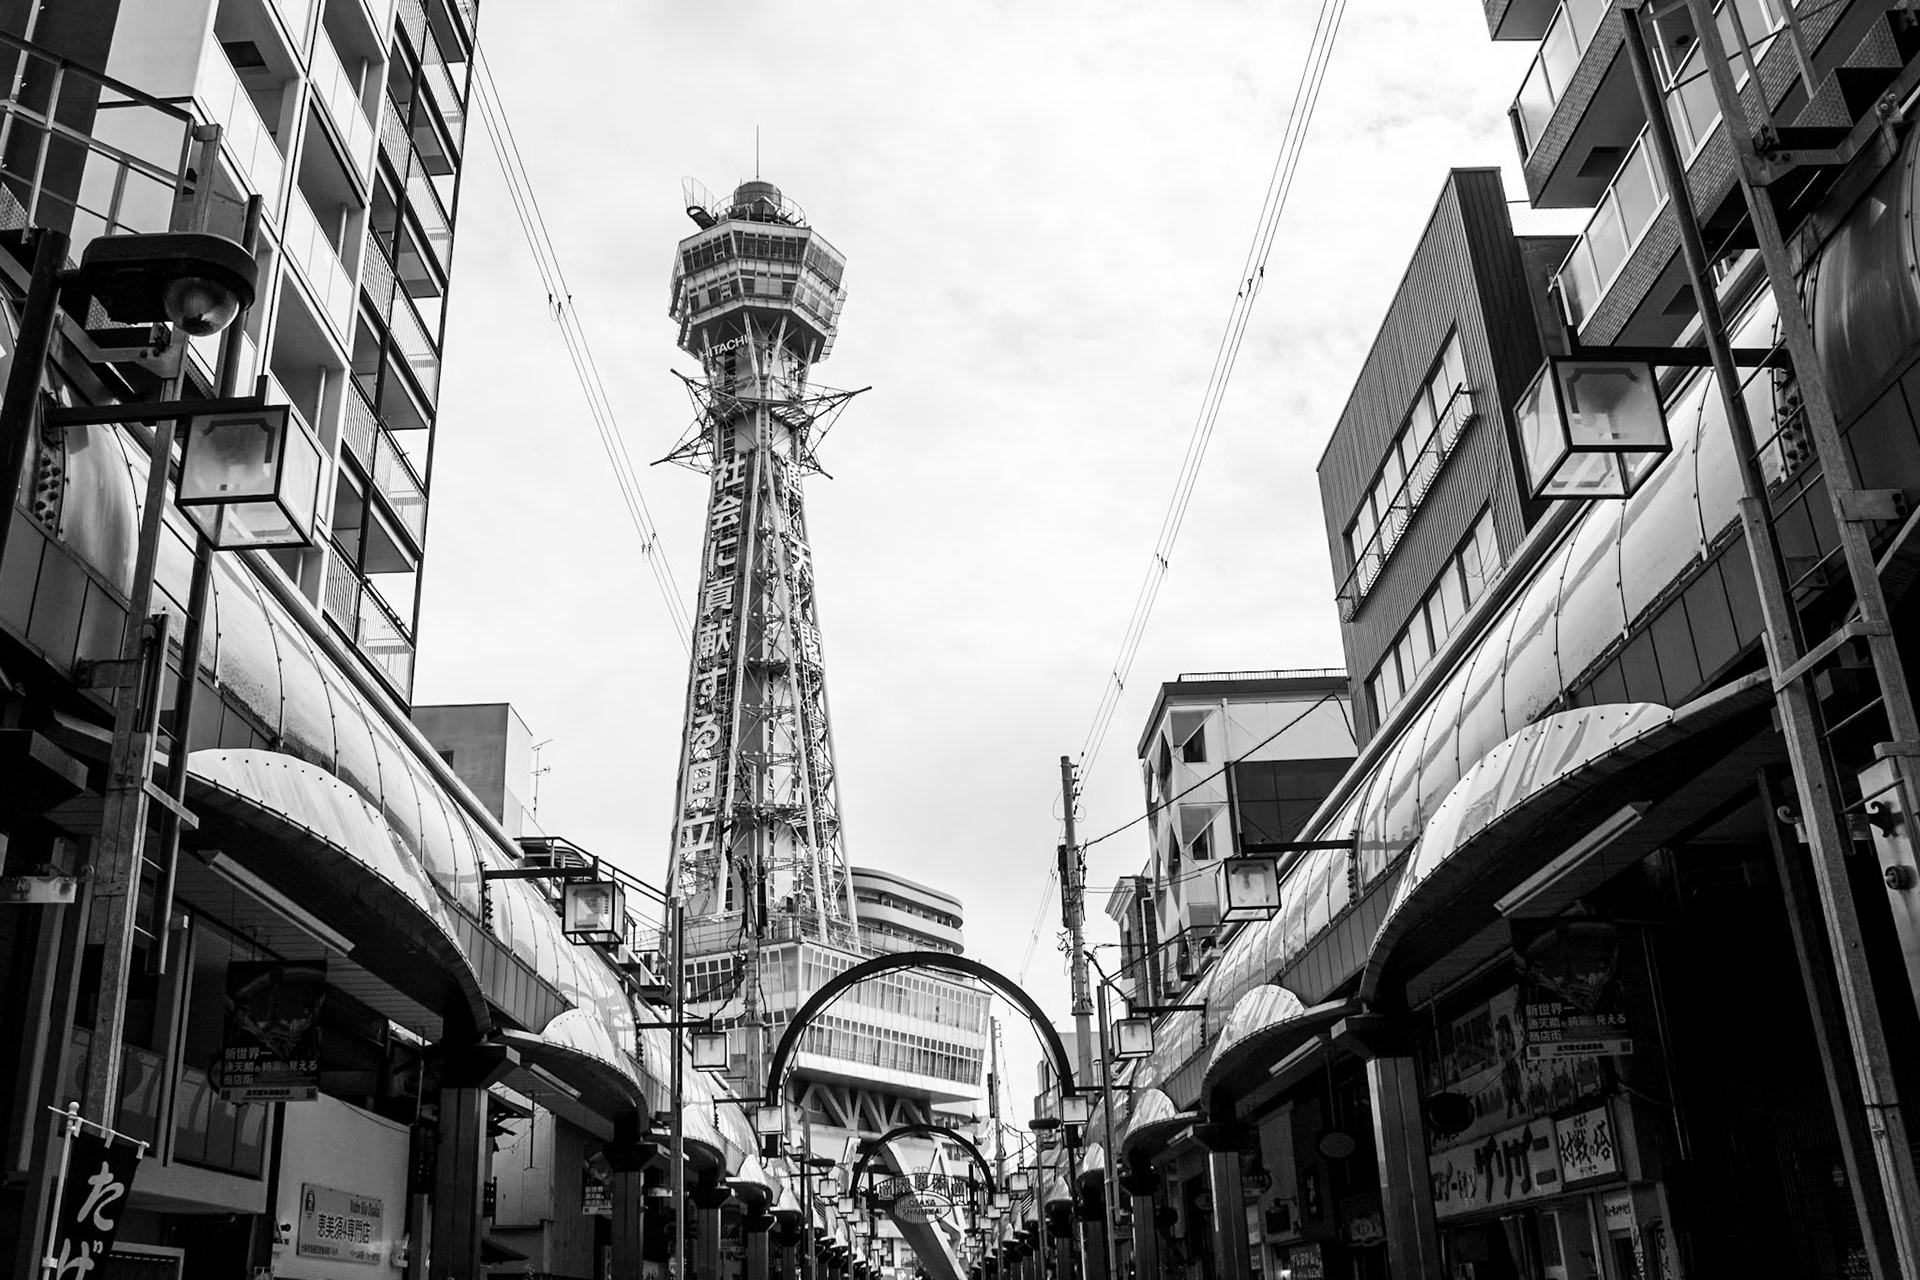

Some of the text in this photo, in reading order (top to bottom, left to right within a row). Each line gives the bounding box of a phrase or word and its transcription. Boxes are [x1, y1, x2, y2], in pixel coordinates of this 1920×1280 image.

[698, 334, 748, 360] HITACHI
[678, 454, 747, 855] 社会に貢献する日立
